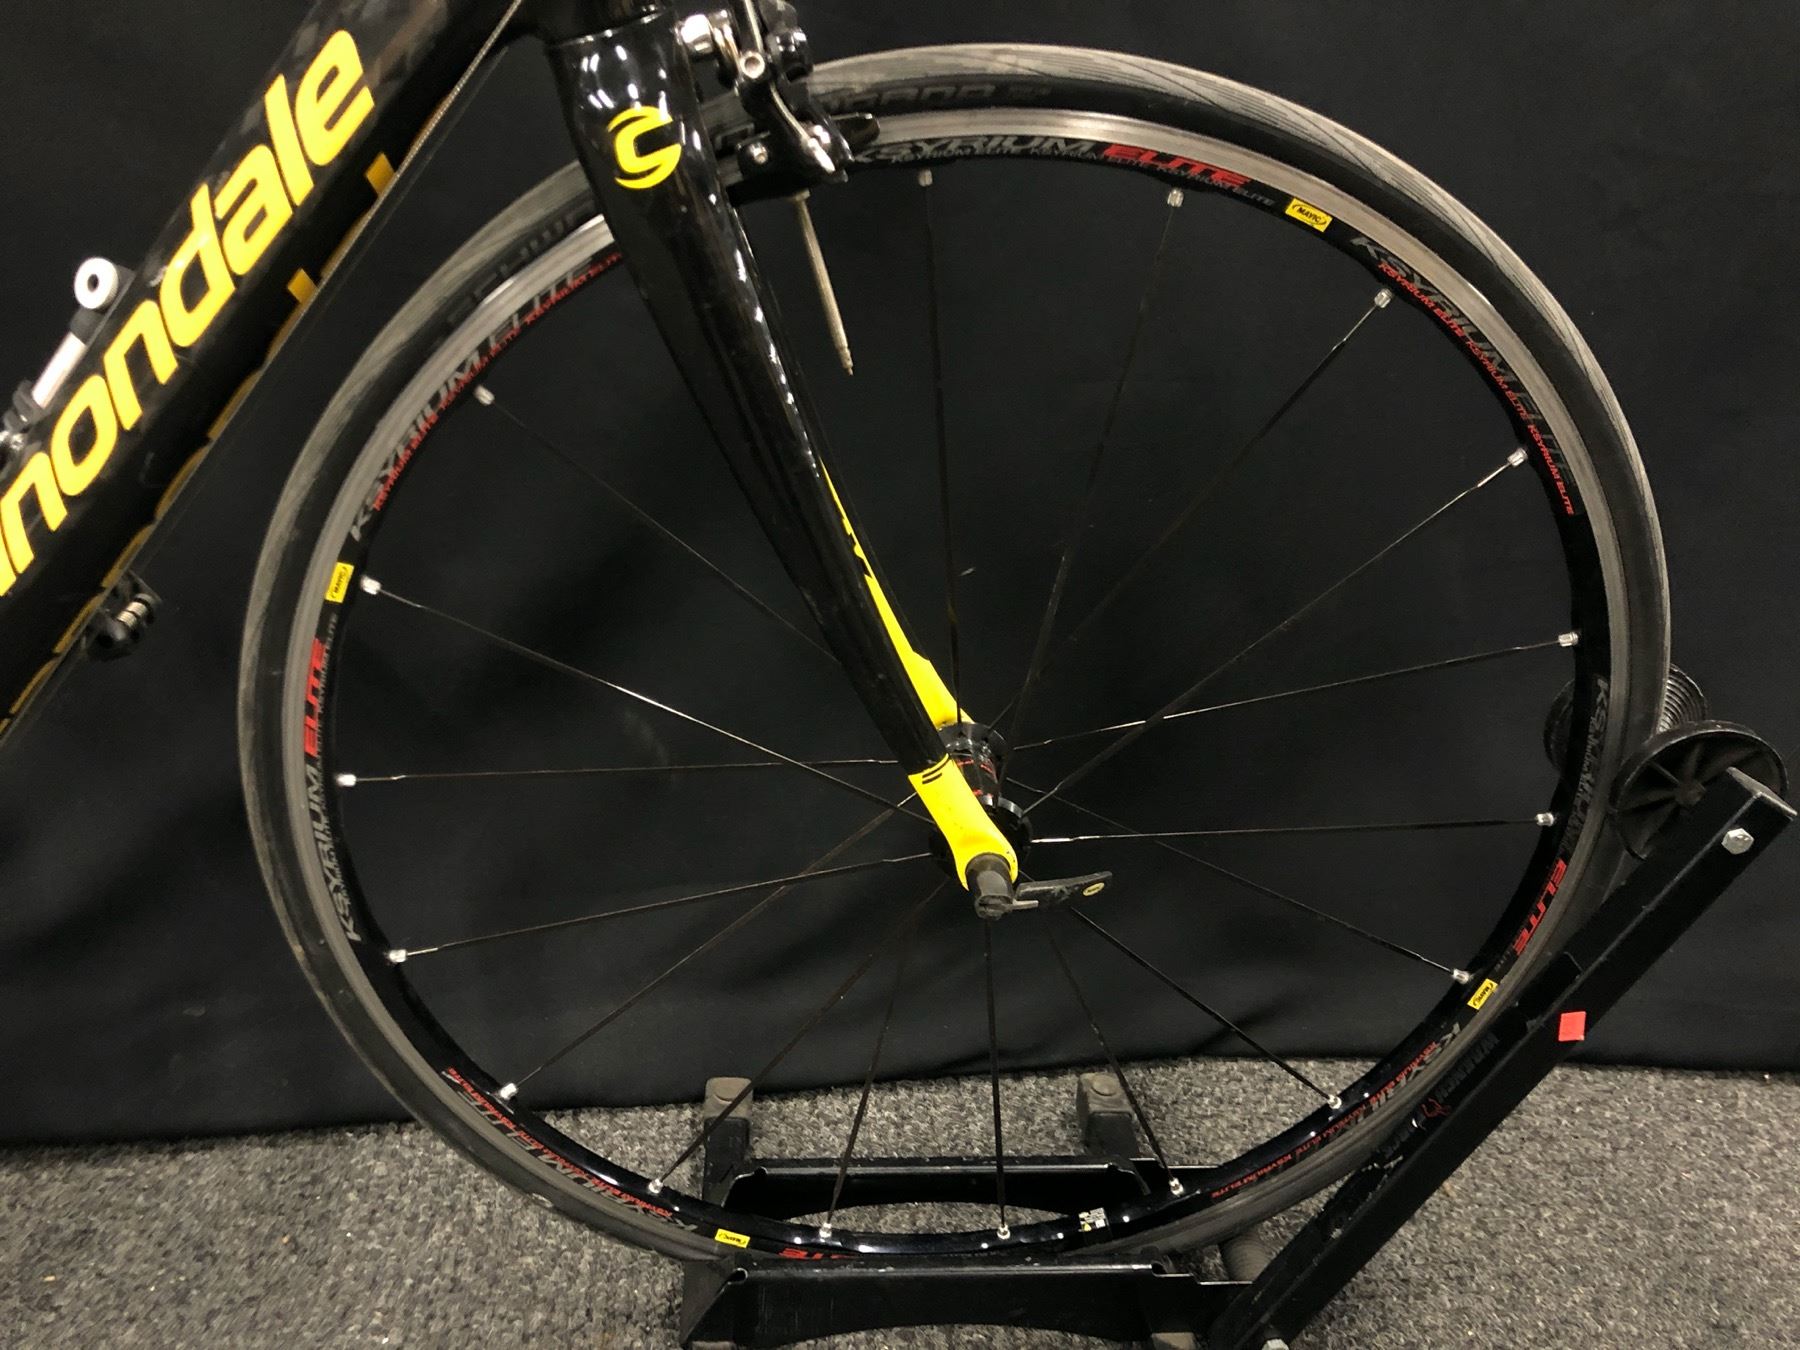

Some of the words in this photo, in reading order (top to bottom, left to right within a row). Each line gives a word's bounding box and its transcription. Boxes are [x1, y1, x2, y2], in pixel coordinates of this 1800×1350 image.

[1102, 141, 1250, 188] ELITE
[1349, 235, 1517, 380] KSYRIUM
[1377, 263, 1436, 305] KSYRIUM
[1431, 308, 1465, 335] ELITE
[1464, 341, 1509, 387] KSYRIUM
[1526, 425, 1560, 477] KSYRIUM
[1554, 480, 1574, 513] ELITE
[303, 636, 326, 757] ELITE
[305, 763, 361, 940] KSYRIUM
[1513, 857, 1567, 957] ELITE
